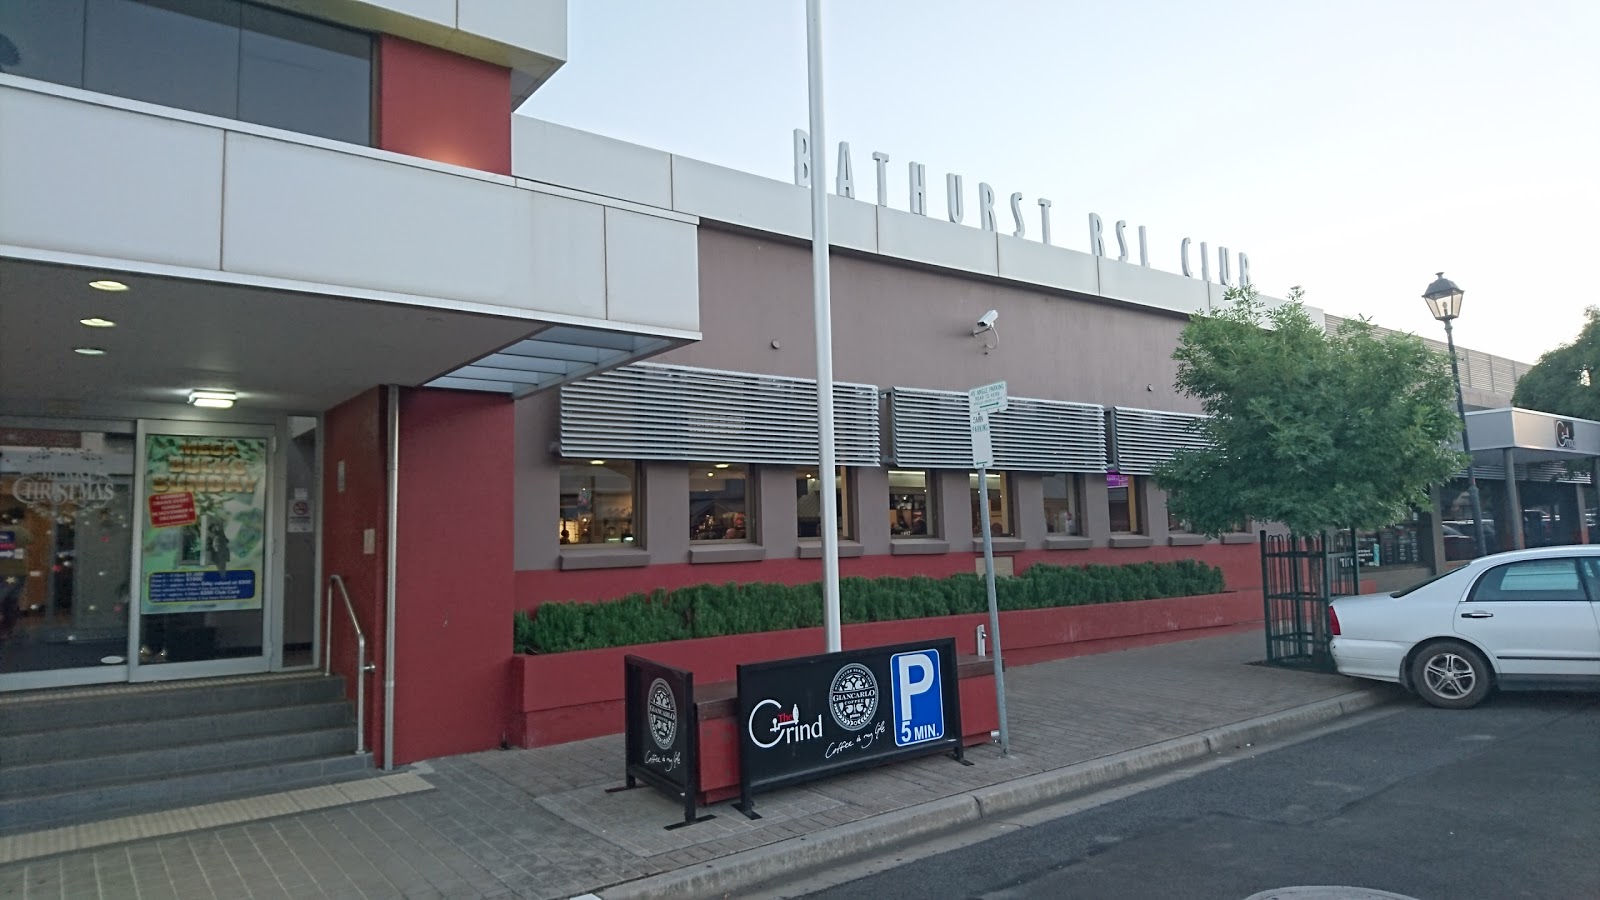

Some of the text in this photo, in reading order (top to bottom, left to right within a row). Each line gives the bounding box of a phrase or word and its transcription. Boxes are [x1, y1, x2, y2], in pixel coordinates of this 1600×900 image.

[793, 128, 1252, 287] BATHURST RSL CLUB
[976, 387, 988, 396] ANGLE
[988, 383, 1005, 392] PARKING
[972, 423, 988, 433] PARKING
[12, 477, 114, 508] CHRISTMAS
[152, 474, 257, 493] SUNDAY
[832, 689, 876, 702] GIANCARLO
[899, 654, 934, 721] P
[844, 698, 865, 706] COFFEE
[748, 699, 823, 748] Grind
[778, 713, 793, 722] The
[902, 721, 940, 742] 5 MIN.
[825, 742, 854, 759] Coffee
